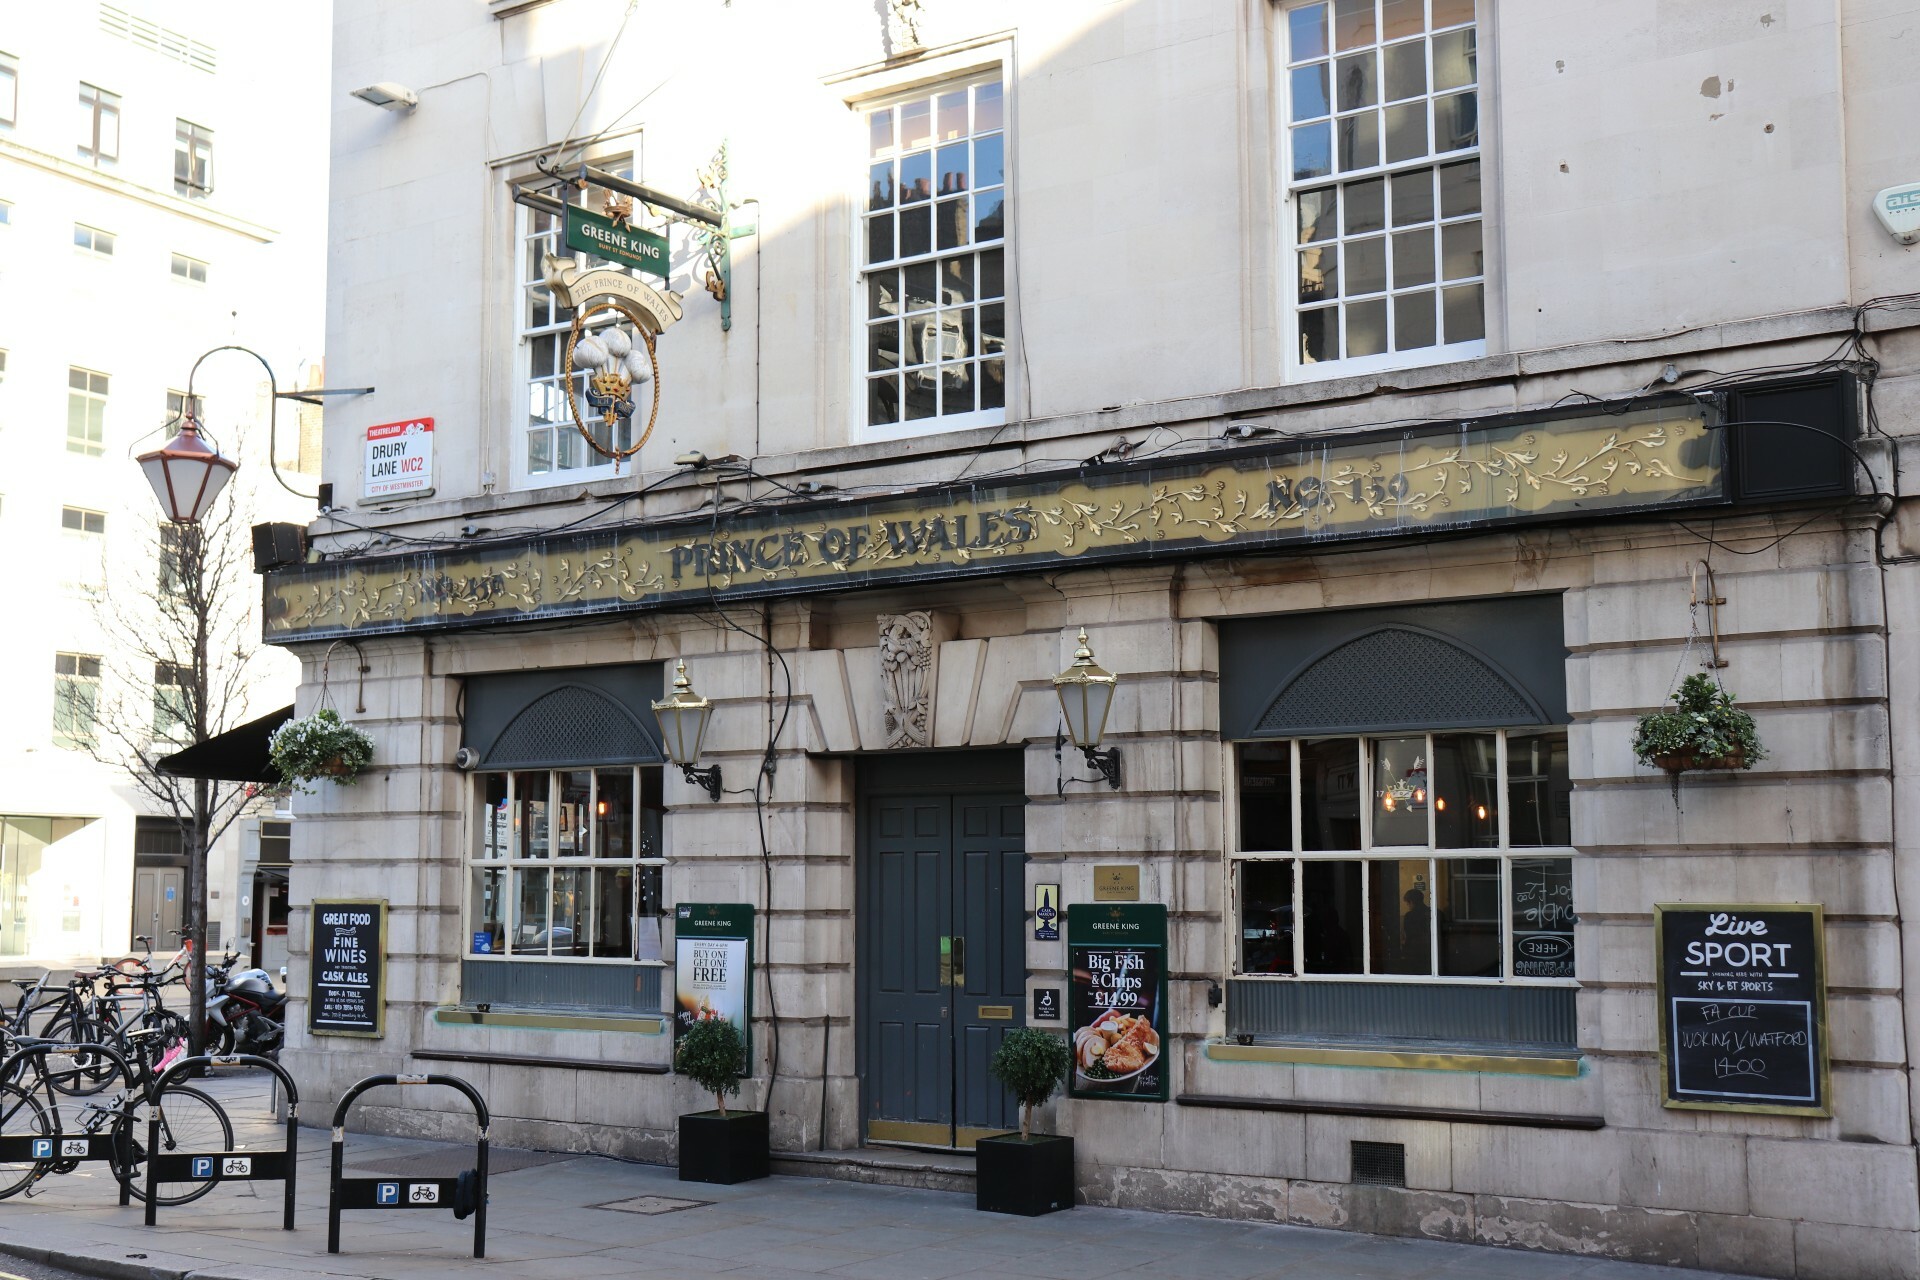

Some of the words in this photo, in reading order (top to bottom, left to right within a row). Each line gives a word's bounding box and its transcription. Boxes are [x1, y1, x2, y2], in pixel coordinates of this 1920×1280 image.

[581, 223, 627, 249] GREENE
[630, 239, 660, 259] KING
[575, 283, 592, 299] THE
[594, 277, 623, 289] PRINCE
[626, 283, 640, 294] OF
[643, 291, 669, 323] WALES
[369, 425, 401, 437] THEATRELAND
[372, 441, 408, 460] DRURY
[371, 460, 397, 478] LANE
[401, 456, 424, 473] WC2
[389, 480, 424, 490] WESTMINSTER
[670, 530, 812, 580] PRINCE
[817, 524, 871, 564] OF
[884, 506, 1037, 556] WALES
[1376, 790, 1385, 798] 17
[323, 913, 349, 925] GREAT
[349, 913, 371, 926] FOOD
[1092, 922, 1120, 930] GREENE
[1704, 913, 1768, 937] Live
[333, 936, 359, 949] FINE
[1527, 942, 1558, 953] HERE
[325, 949, 367, 964] WINES
[694, 949, 710, 959] BUY
[711, 950, 728, 960] ONE
[1684, 941, 1792, 967] SPORT
[693, 958, 709, 967] GET
[710, 959, 728, 968] ONE
[1088, 954, 1111, 973] Big
[1114, 954, 1145, 970] Fish
[322, 970, 345, 982] CASK
[346, 972, 369, 983] ALES
[693, 967, 727, 983] FREE
[1091, 974, 1100, 985] &
[1100, 972, 1142, 992] Chips
[1697, 980, 1714, 991] SKY
[1716, 981, 1726, 992] &
[1726, 981, 1739, 991] BT
[1740, 981, 1774, 992] SPORTS
[1094, 991, 1138, 1007] £14.99
[1701, 1004, 1720, 1020] FA
[1728, 1004, 1756, 1017] CUP
[1682, 1030, 1731, 1051] WOKING
[1749, 1030, 1808, 1047] WATFORD
[36, 1141, 50, 1156] P
[195, 1160, 209, 1175] P
[382, 1186, 397, 1201] P
